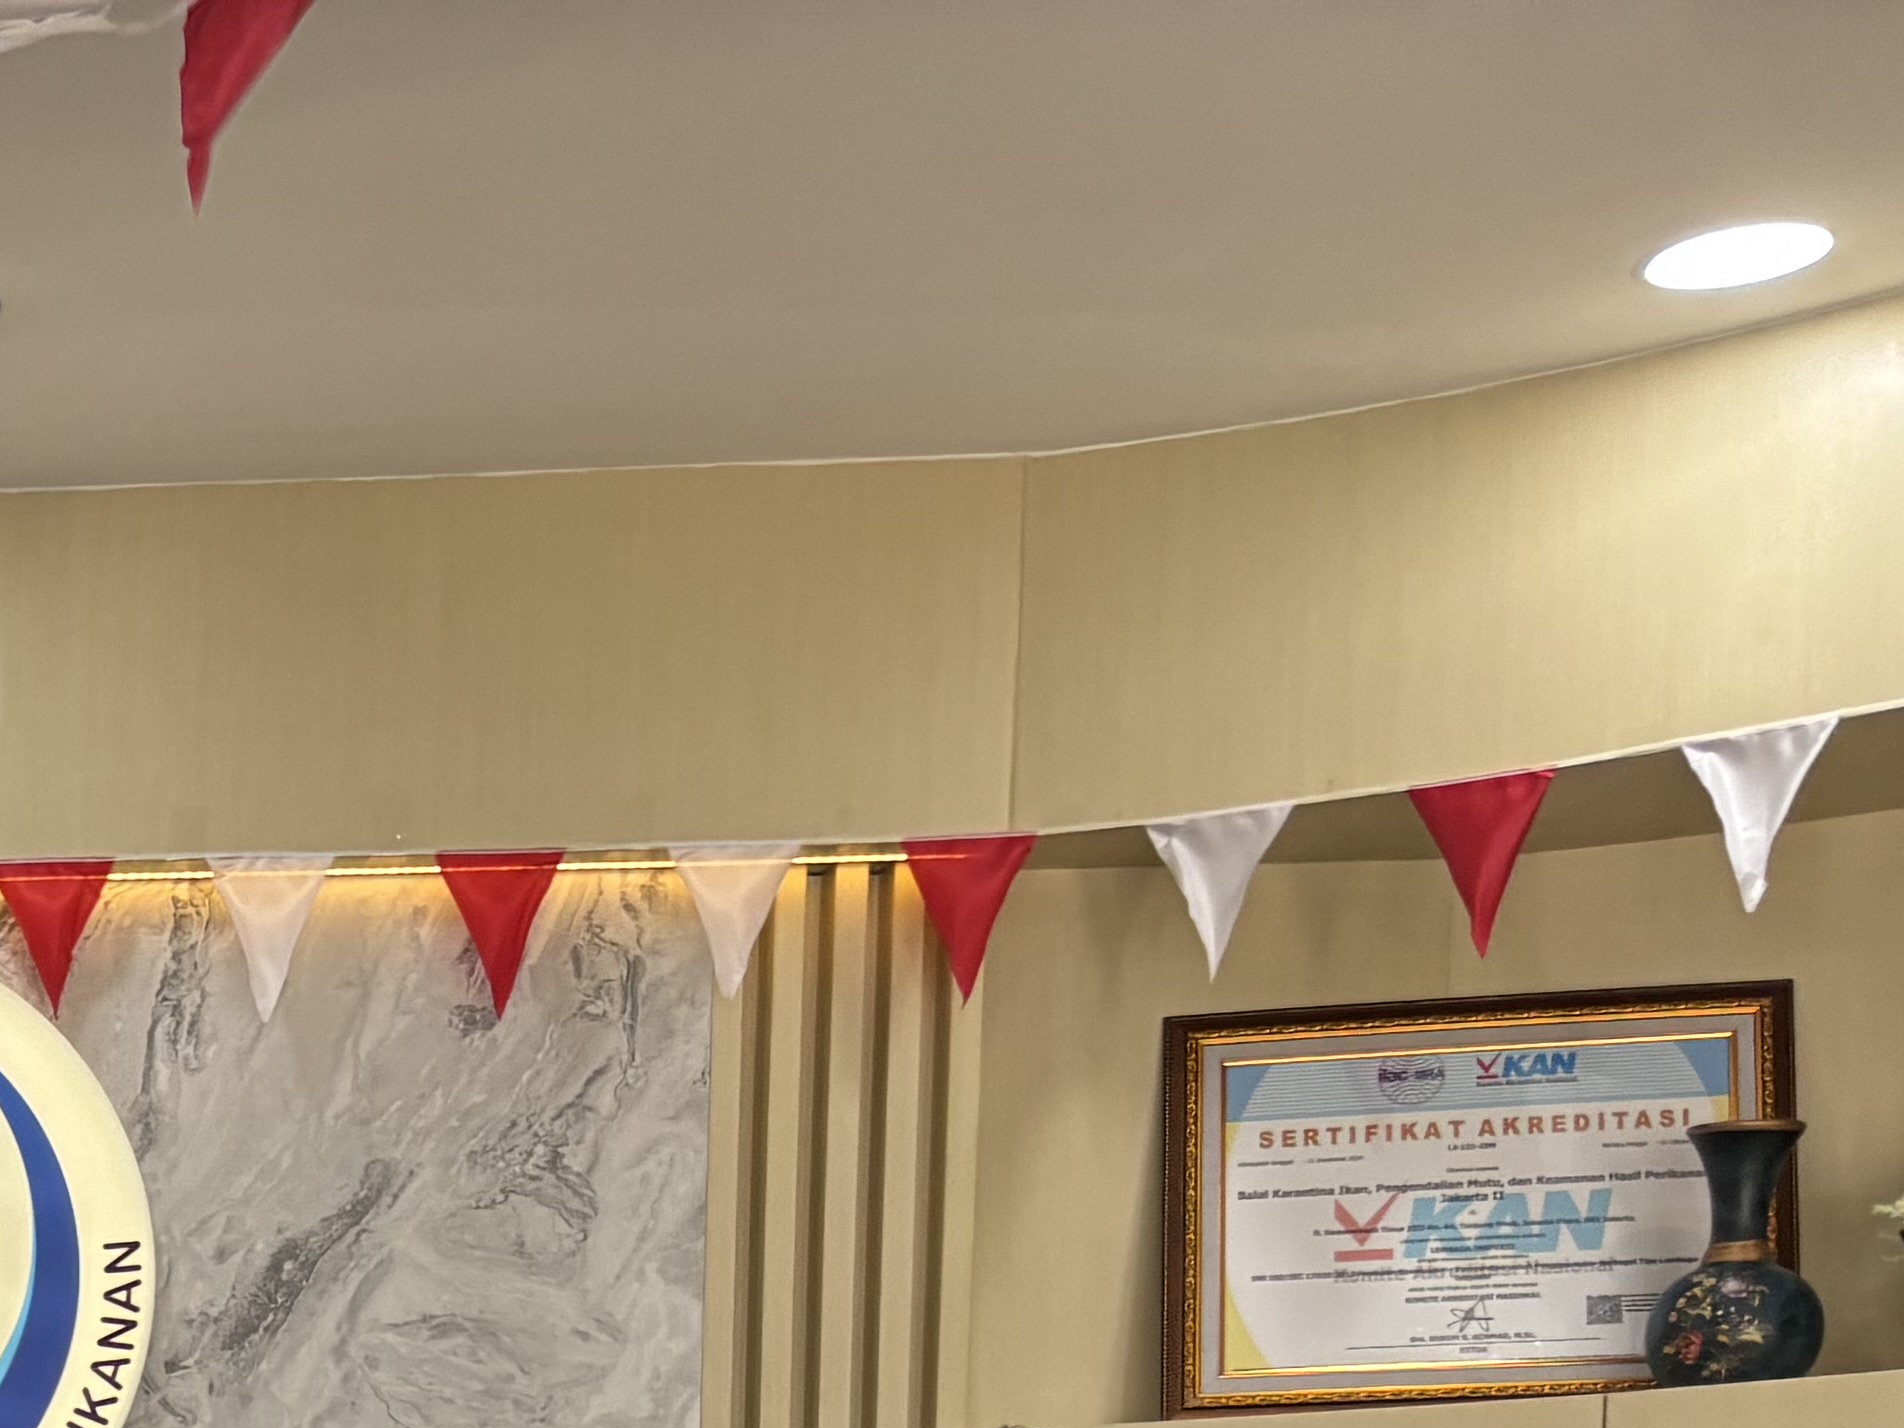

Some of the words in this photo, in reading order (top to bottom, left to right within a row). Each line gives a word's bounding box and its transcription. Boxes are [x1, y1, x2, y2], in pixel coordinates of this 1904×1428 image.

[1502, 1051, 1577, 1078] KAN
[1258, 1119, 1466, 1150] SERTIFIKAT
[1478, 1108, 1690, 1137] AKREDITASI
[1403, 1187, 1612, 1259] KAN
